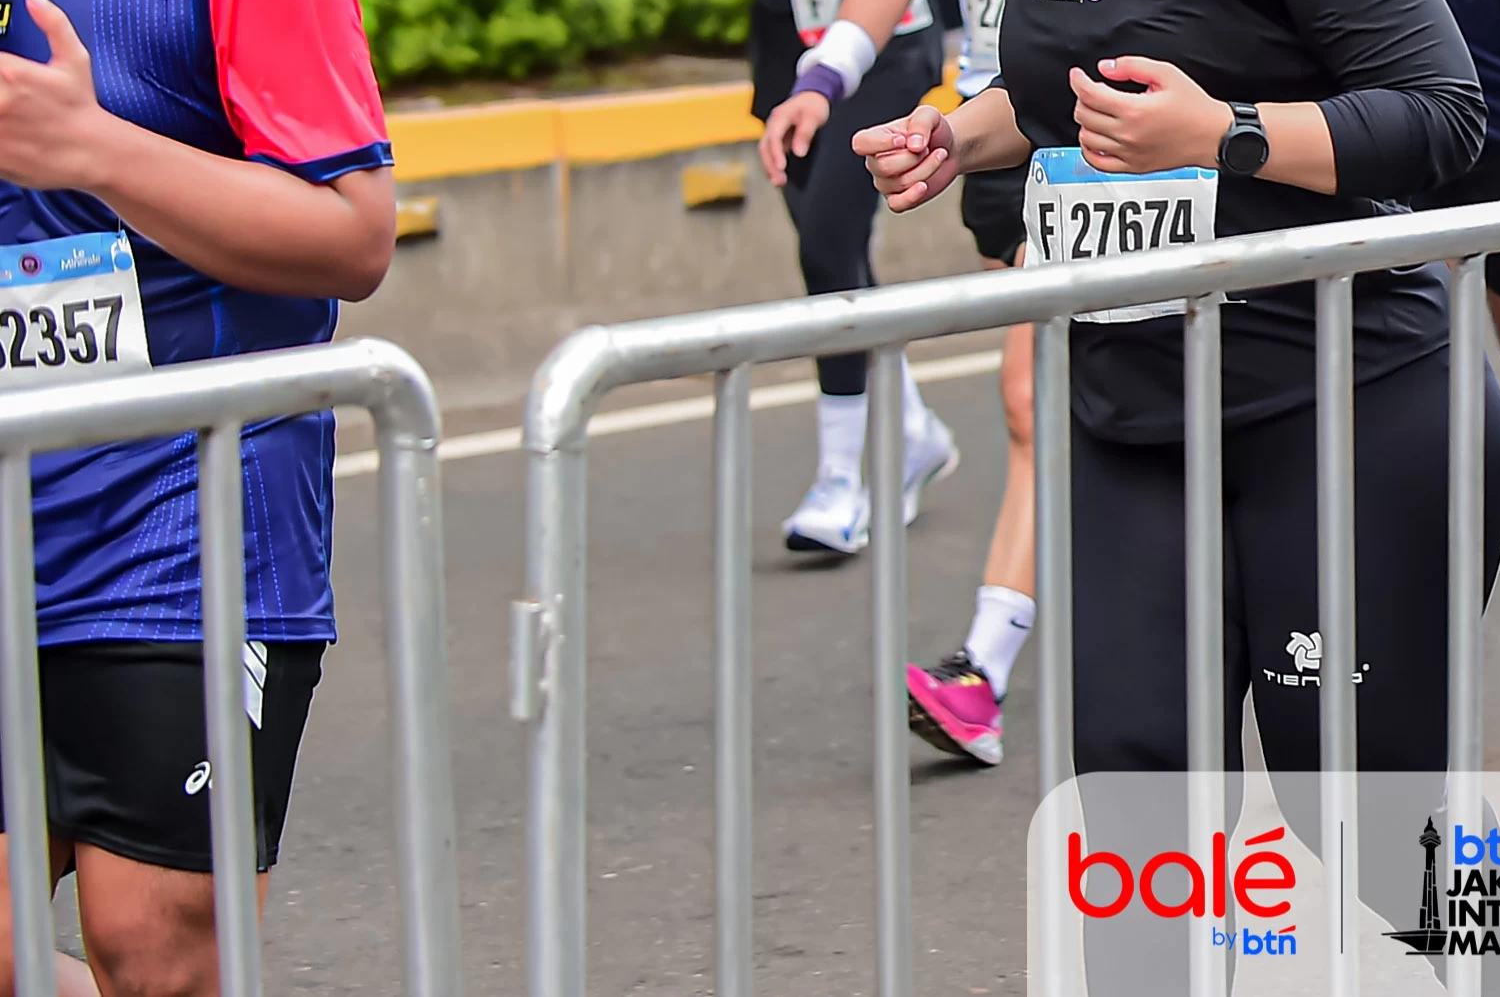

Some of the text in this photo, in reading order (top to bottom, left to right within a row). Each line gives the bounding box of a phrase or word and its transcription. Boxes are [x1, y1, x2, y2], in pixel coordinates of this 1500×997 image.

[1038, 198, 1196, 260] F 27674
[0, 294, 124, 369] 2357
